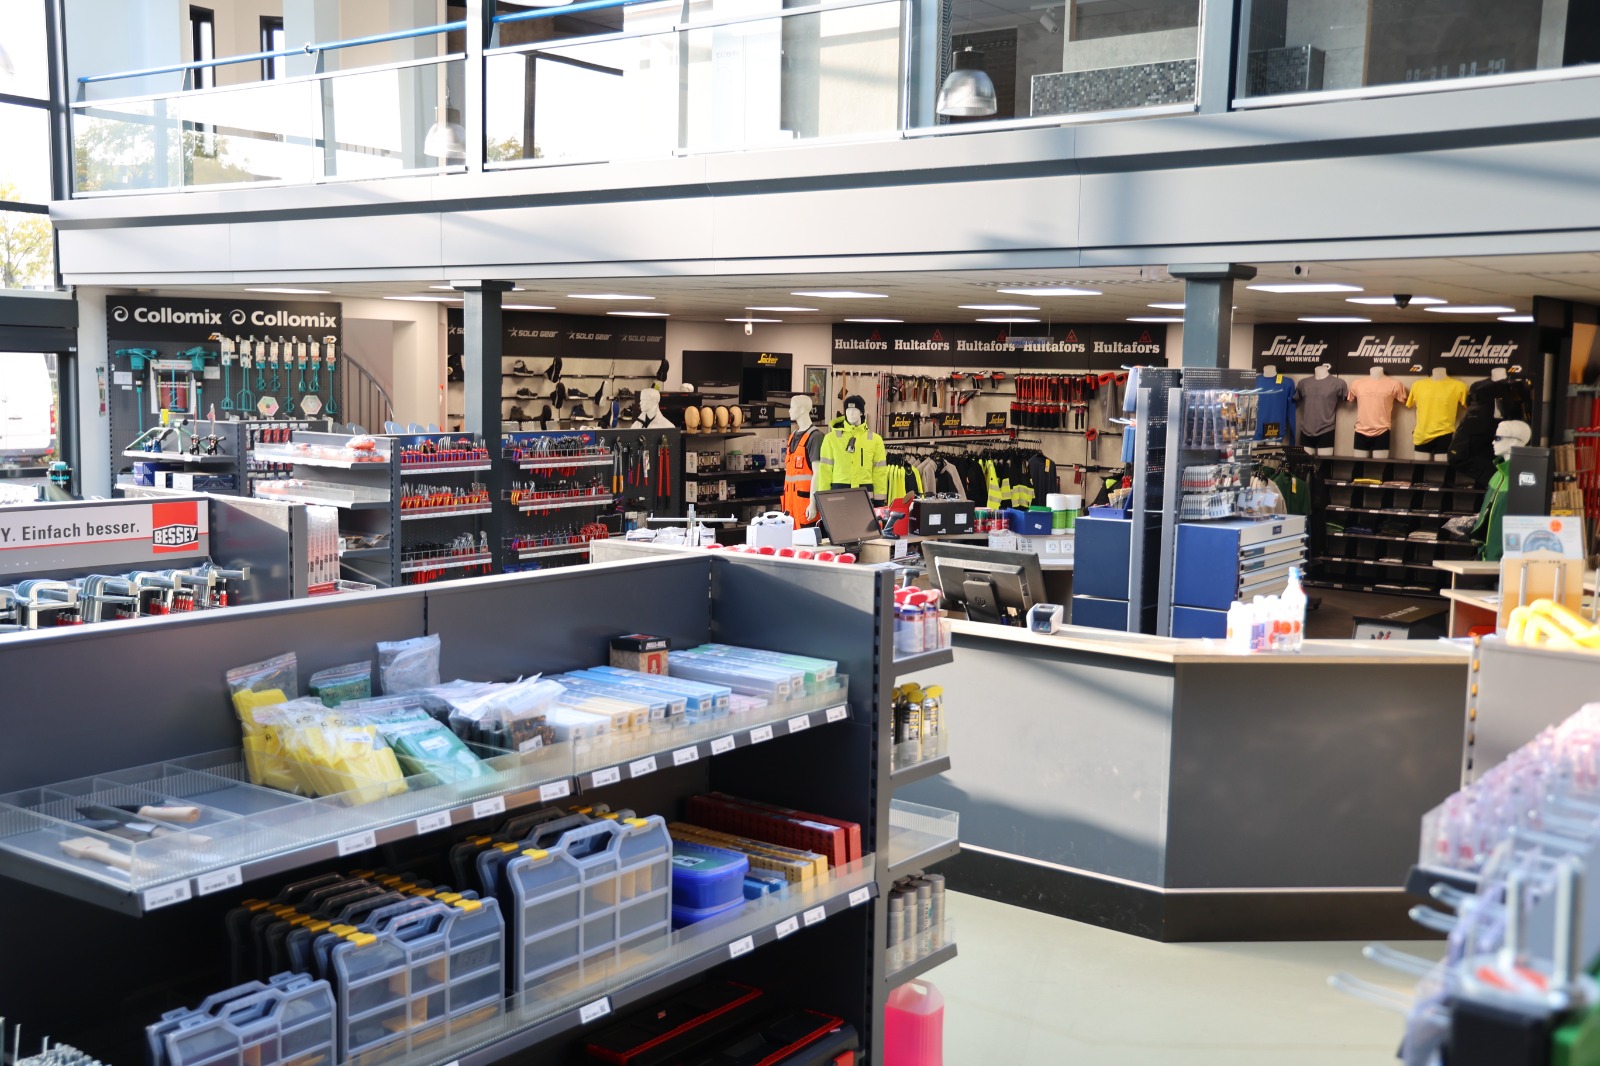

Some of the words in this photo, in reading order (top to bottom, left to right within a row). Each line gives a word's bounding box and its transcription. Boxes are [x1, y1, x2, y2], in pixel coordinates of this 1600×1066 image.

[134, 307, 222, 325] Collomix
[251, 310, 337, 328] Collomix
[834, 339, 888, 350] Hultafors
[894, 339, 950, 351] Hultafors
[956, 340, 1016, 351] Hultafors
[1023, 340, 1085, 353] Hultafors
[1093, 341, 1160, 354] Hultafors
[1261, 335, 1328, 356] Snickers
[1347, 335, 1420, 357] Snickers
[1440, 335, 1518, 357] Snickers
[22, 522, 81, 541] Einfach
[86, 522, 140, 536] besser.
[154, 527, 197, 545] BESSEY
